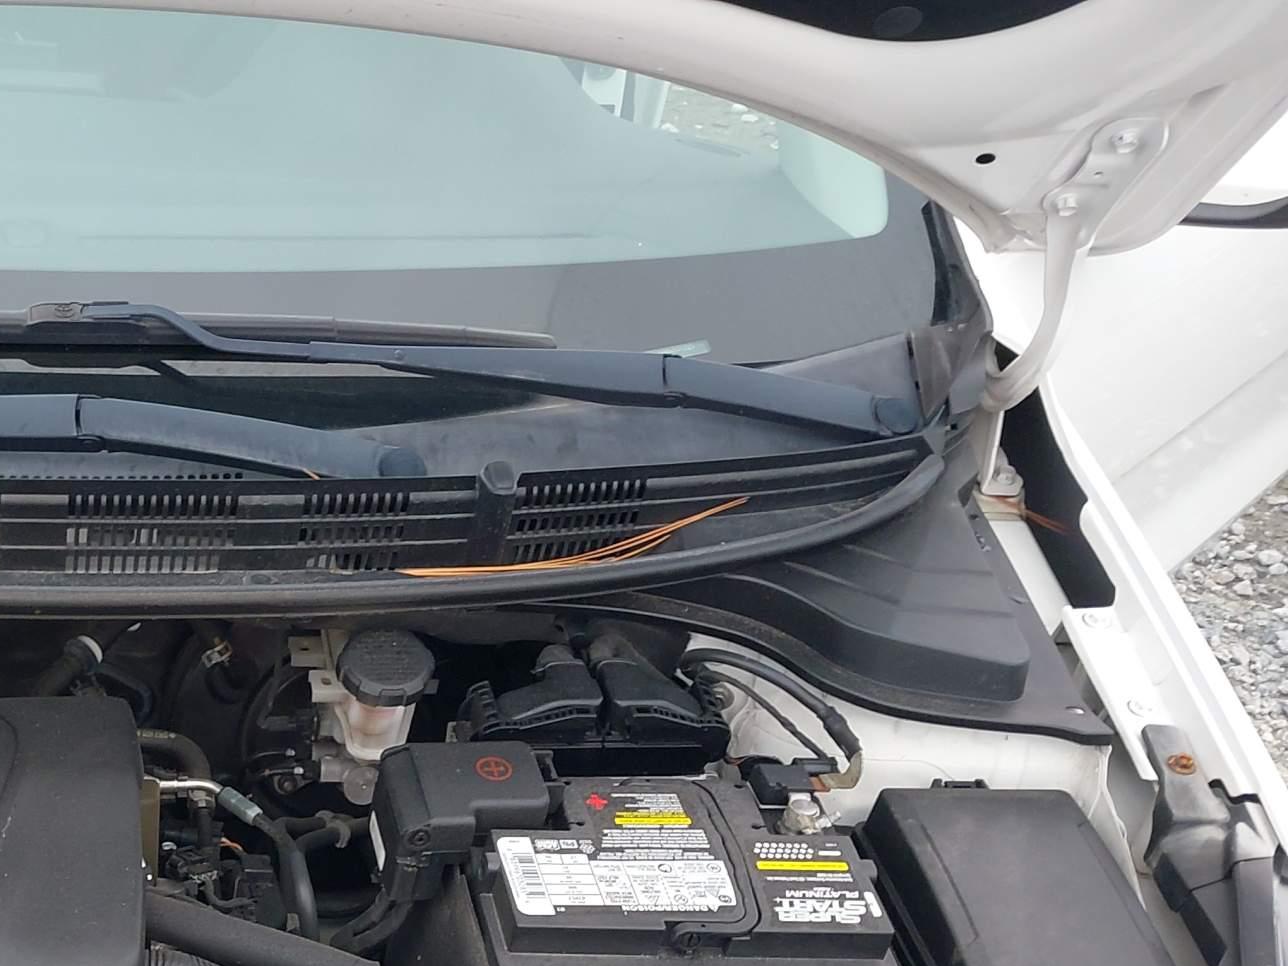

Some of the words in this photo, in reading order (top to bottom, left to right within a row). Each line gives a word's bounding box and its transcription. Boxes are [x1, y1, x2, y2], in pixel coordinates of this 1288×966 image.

[785, 890, 860, 898] PLATINUM
[773, 899, 867, 915] START
[777, 911, 861, 924] SUPER
